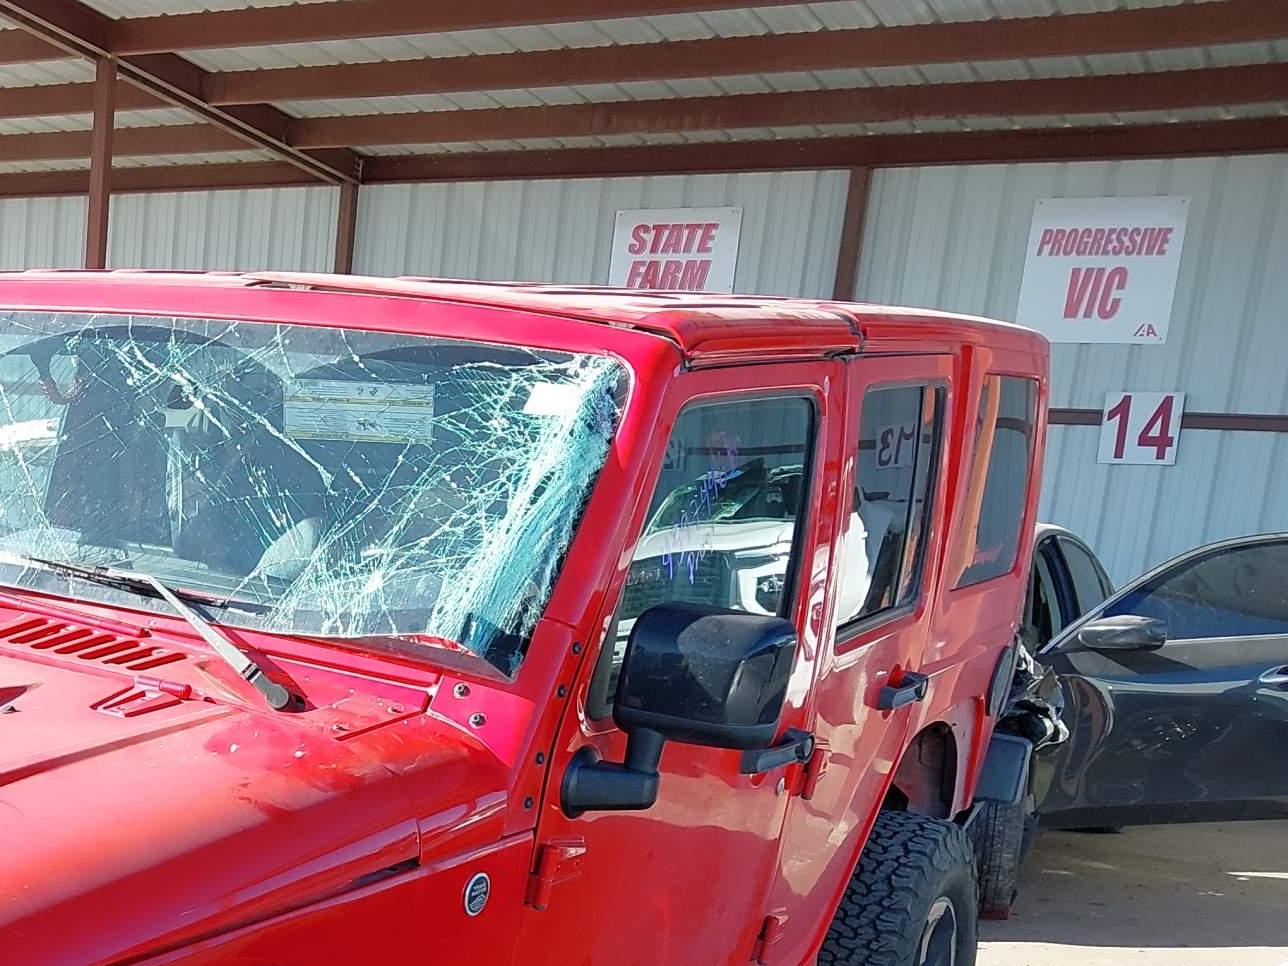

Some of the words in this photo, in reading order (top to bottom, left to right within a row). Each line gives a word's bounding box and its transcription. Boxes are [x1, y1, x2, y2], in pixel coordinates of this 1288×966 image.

[628, 222, 720, 255] STATE
[1037, 227, 1174, 257] PROGRESSIVE
[626, 259, 712, 291] FARM
[1064, 266, 1129, 320] VIC
[1107, 395, 1175, 460] 14
